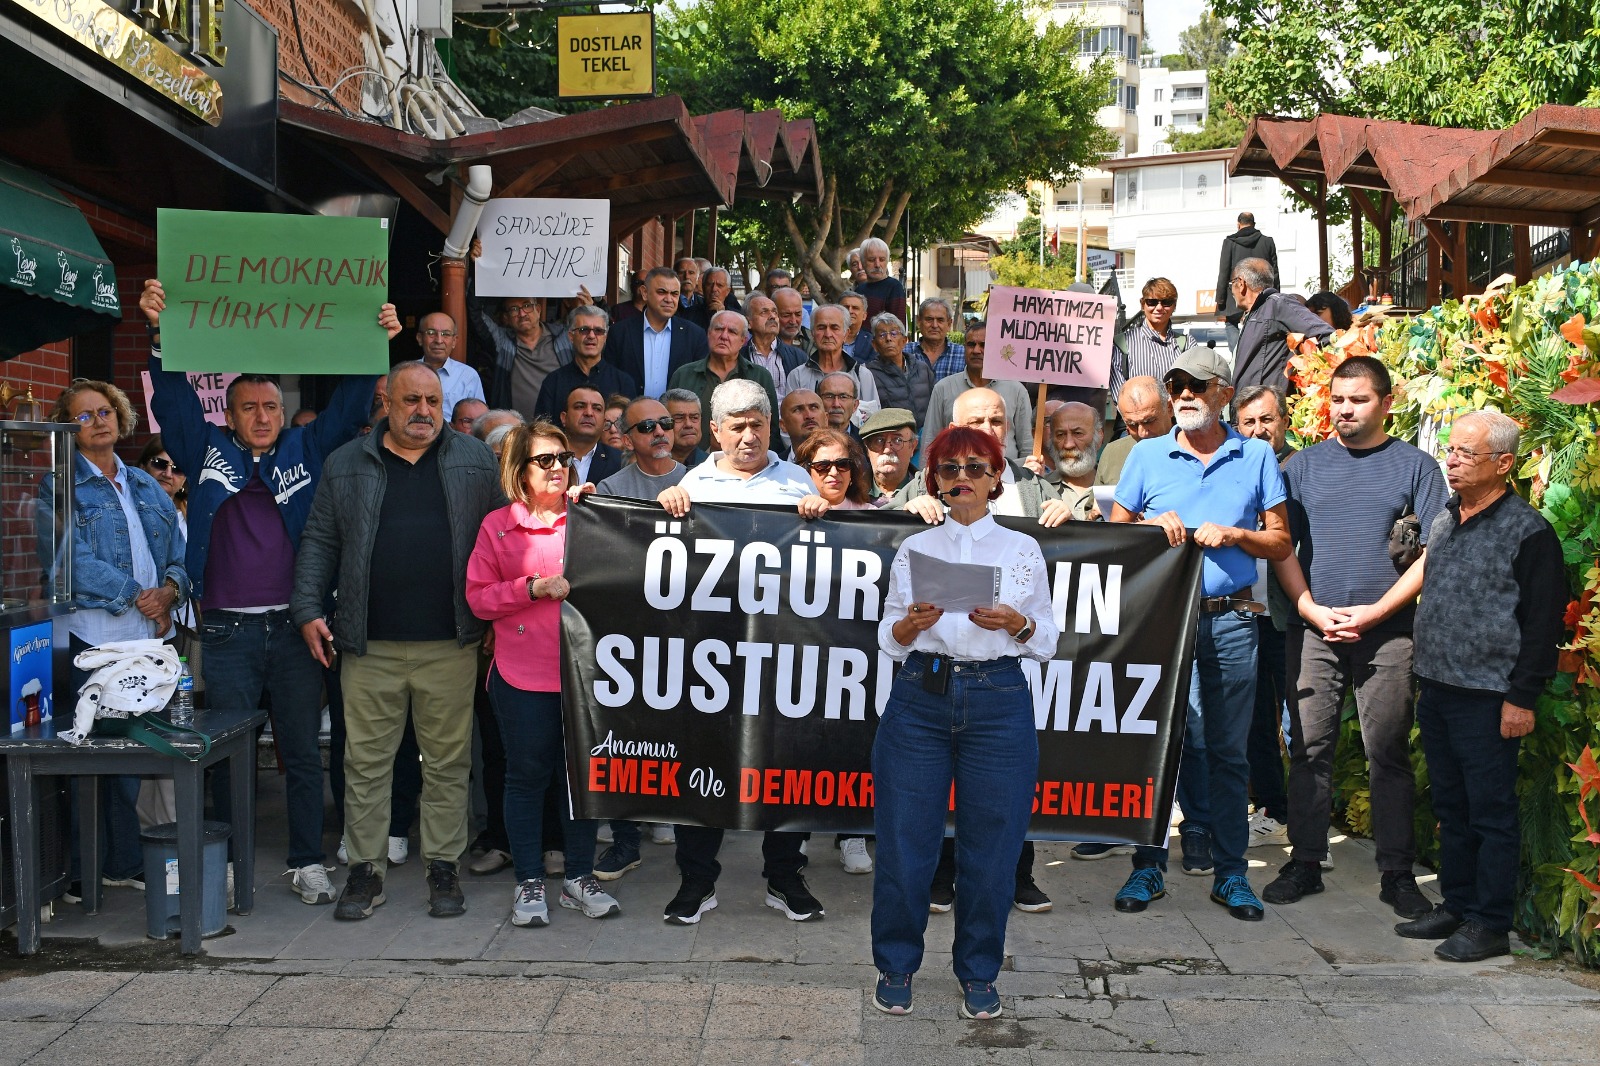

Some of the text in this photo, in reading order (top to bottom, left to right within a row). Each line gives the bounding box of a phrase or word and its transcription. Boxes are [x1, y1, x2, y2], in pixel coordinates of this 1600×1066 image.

[570, 35, 642, 53] DOSTLAR
[581, 56, 631, 73] TEKEL
[495, 211, 594, 236] SANSÜRE
[184, 254, 388, 288] DEMOKRATİK
[502, 246, 588, 279] HAYIR
[180, 296, 338, 330] TÜRKİYE
[1013, 294, 1104, 320] HAYATIMIZA
[1000, 319, 1103, 346] MÜDAHALEYE
[1025, 347, 1083, 375] HAYIR
[203, 445, 243, 483] Mavi
[271, 463, 309, 505] Jean
[643, 520, 883, 622] ÖZGÜR
[590, 729, 678, 759] Anamur
[588, 757, 682, 797] EMEK
[688, 766, 725, 798] Ve
[739, 767, 875, 808] DEMOKR
